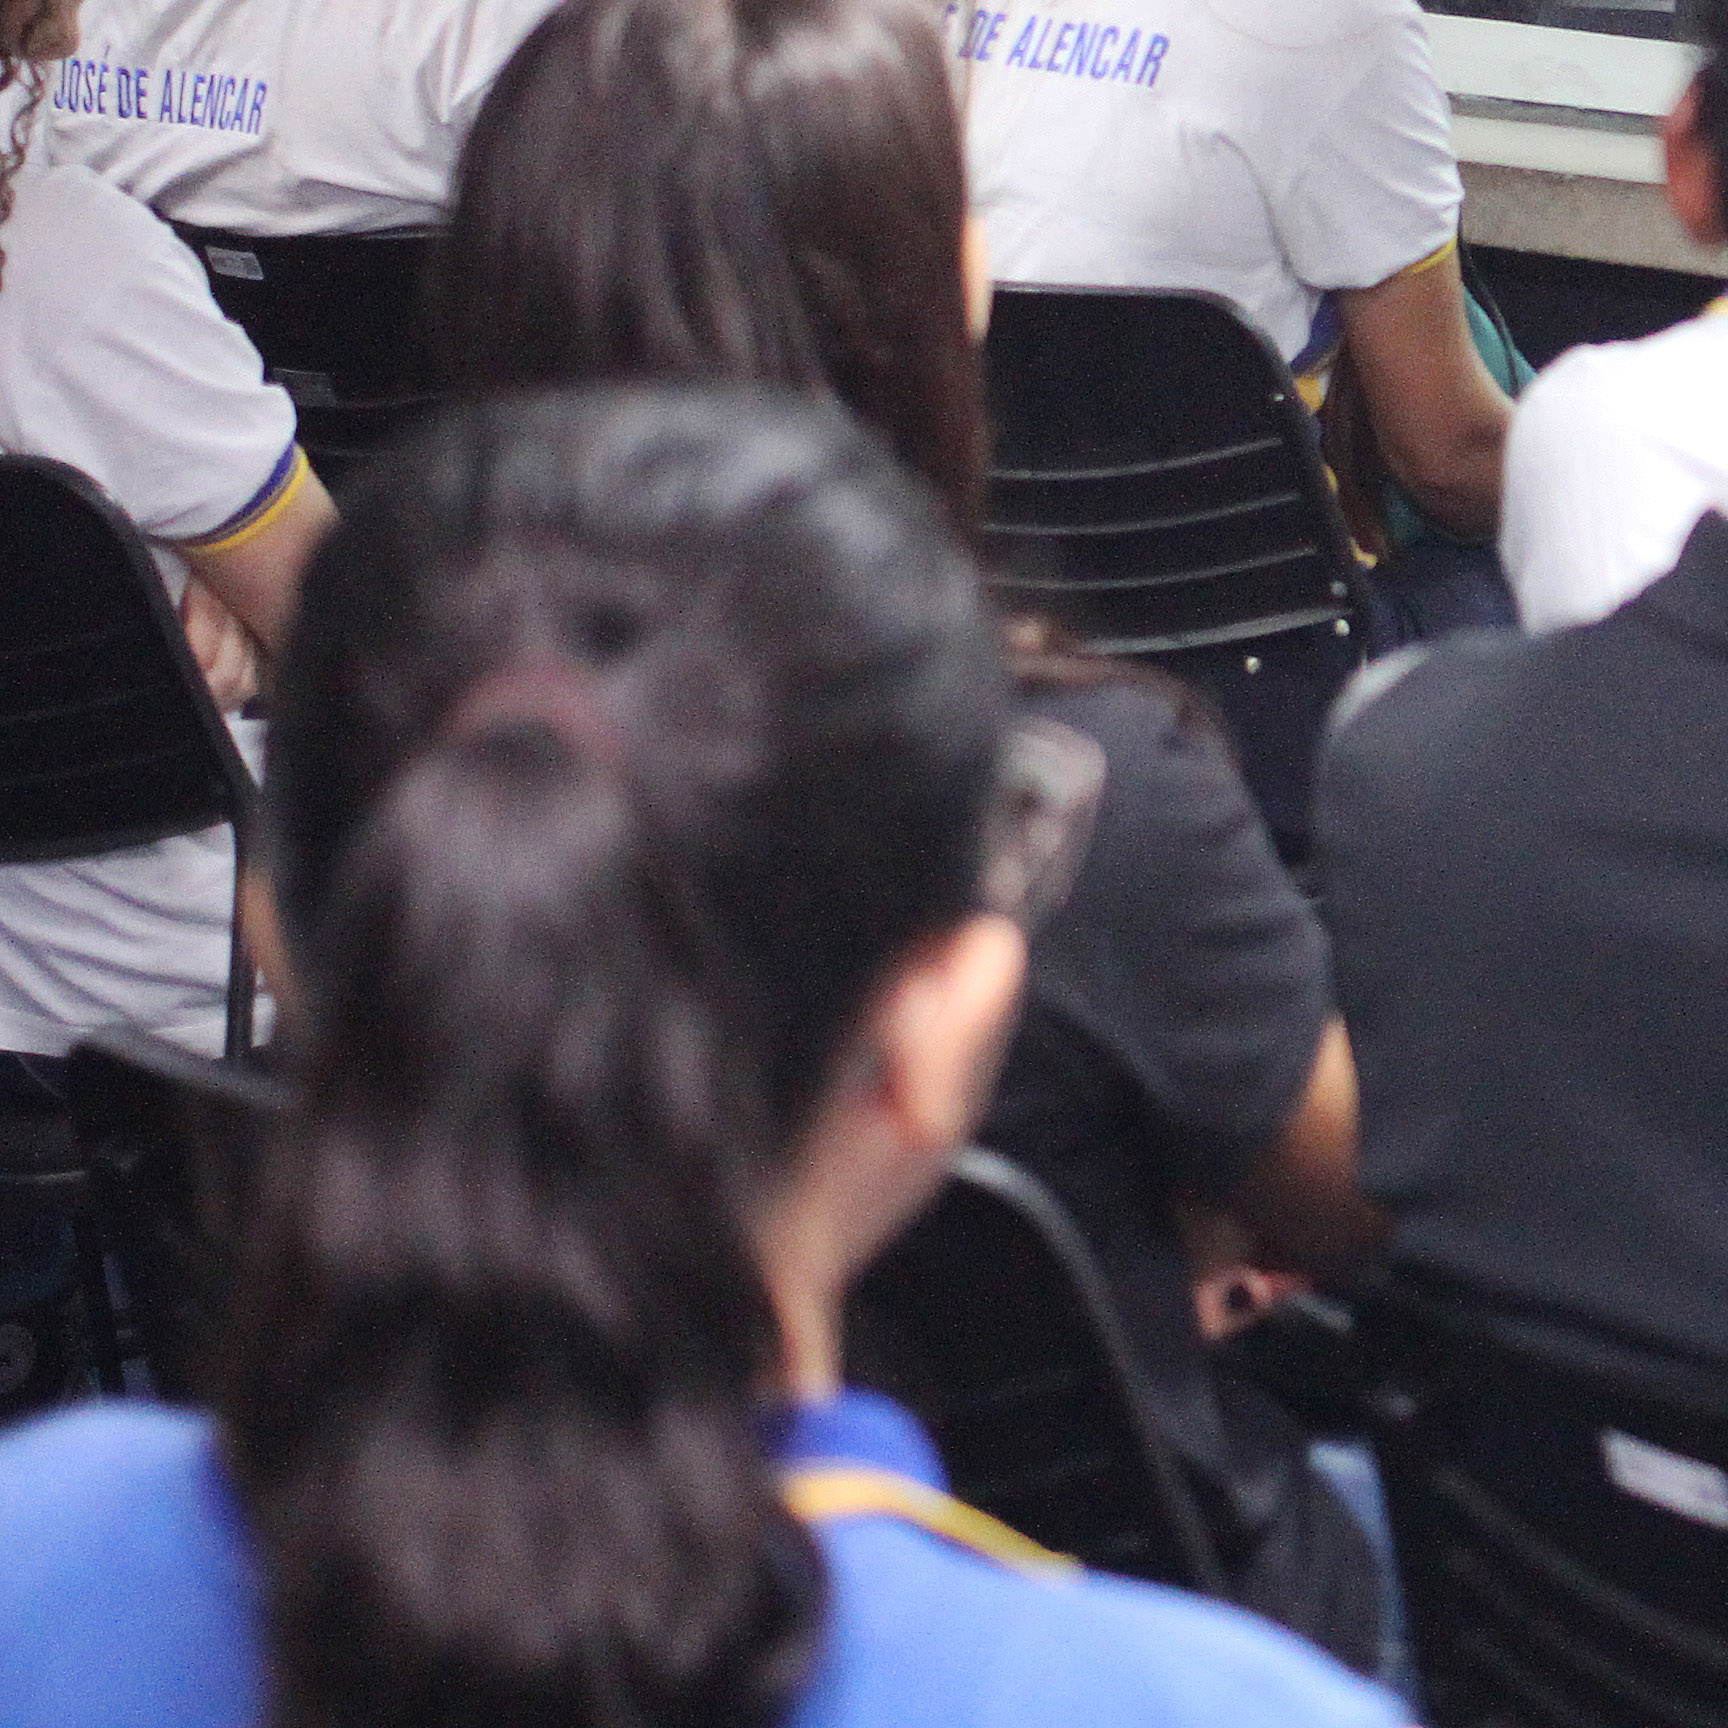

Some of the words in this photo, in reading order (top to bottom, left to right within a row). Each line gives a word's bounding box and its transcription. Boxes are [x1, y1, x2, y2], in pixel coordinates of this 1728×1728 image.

[54, 44, 110, 114] JOSÉ
[117, 67, 149, 119] DE
[159, 70, 268, 135] ALENCAR
[958, 10, 1007, 61] DE
[1006, 15, 1170, 88] ALENCAR
